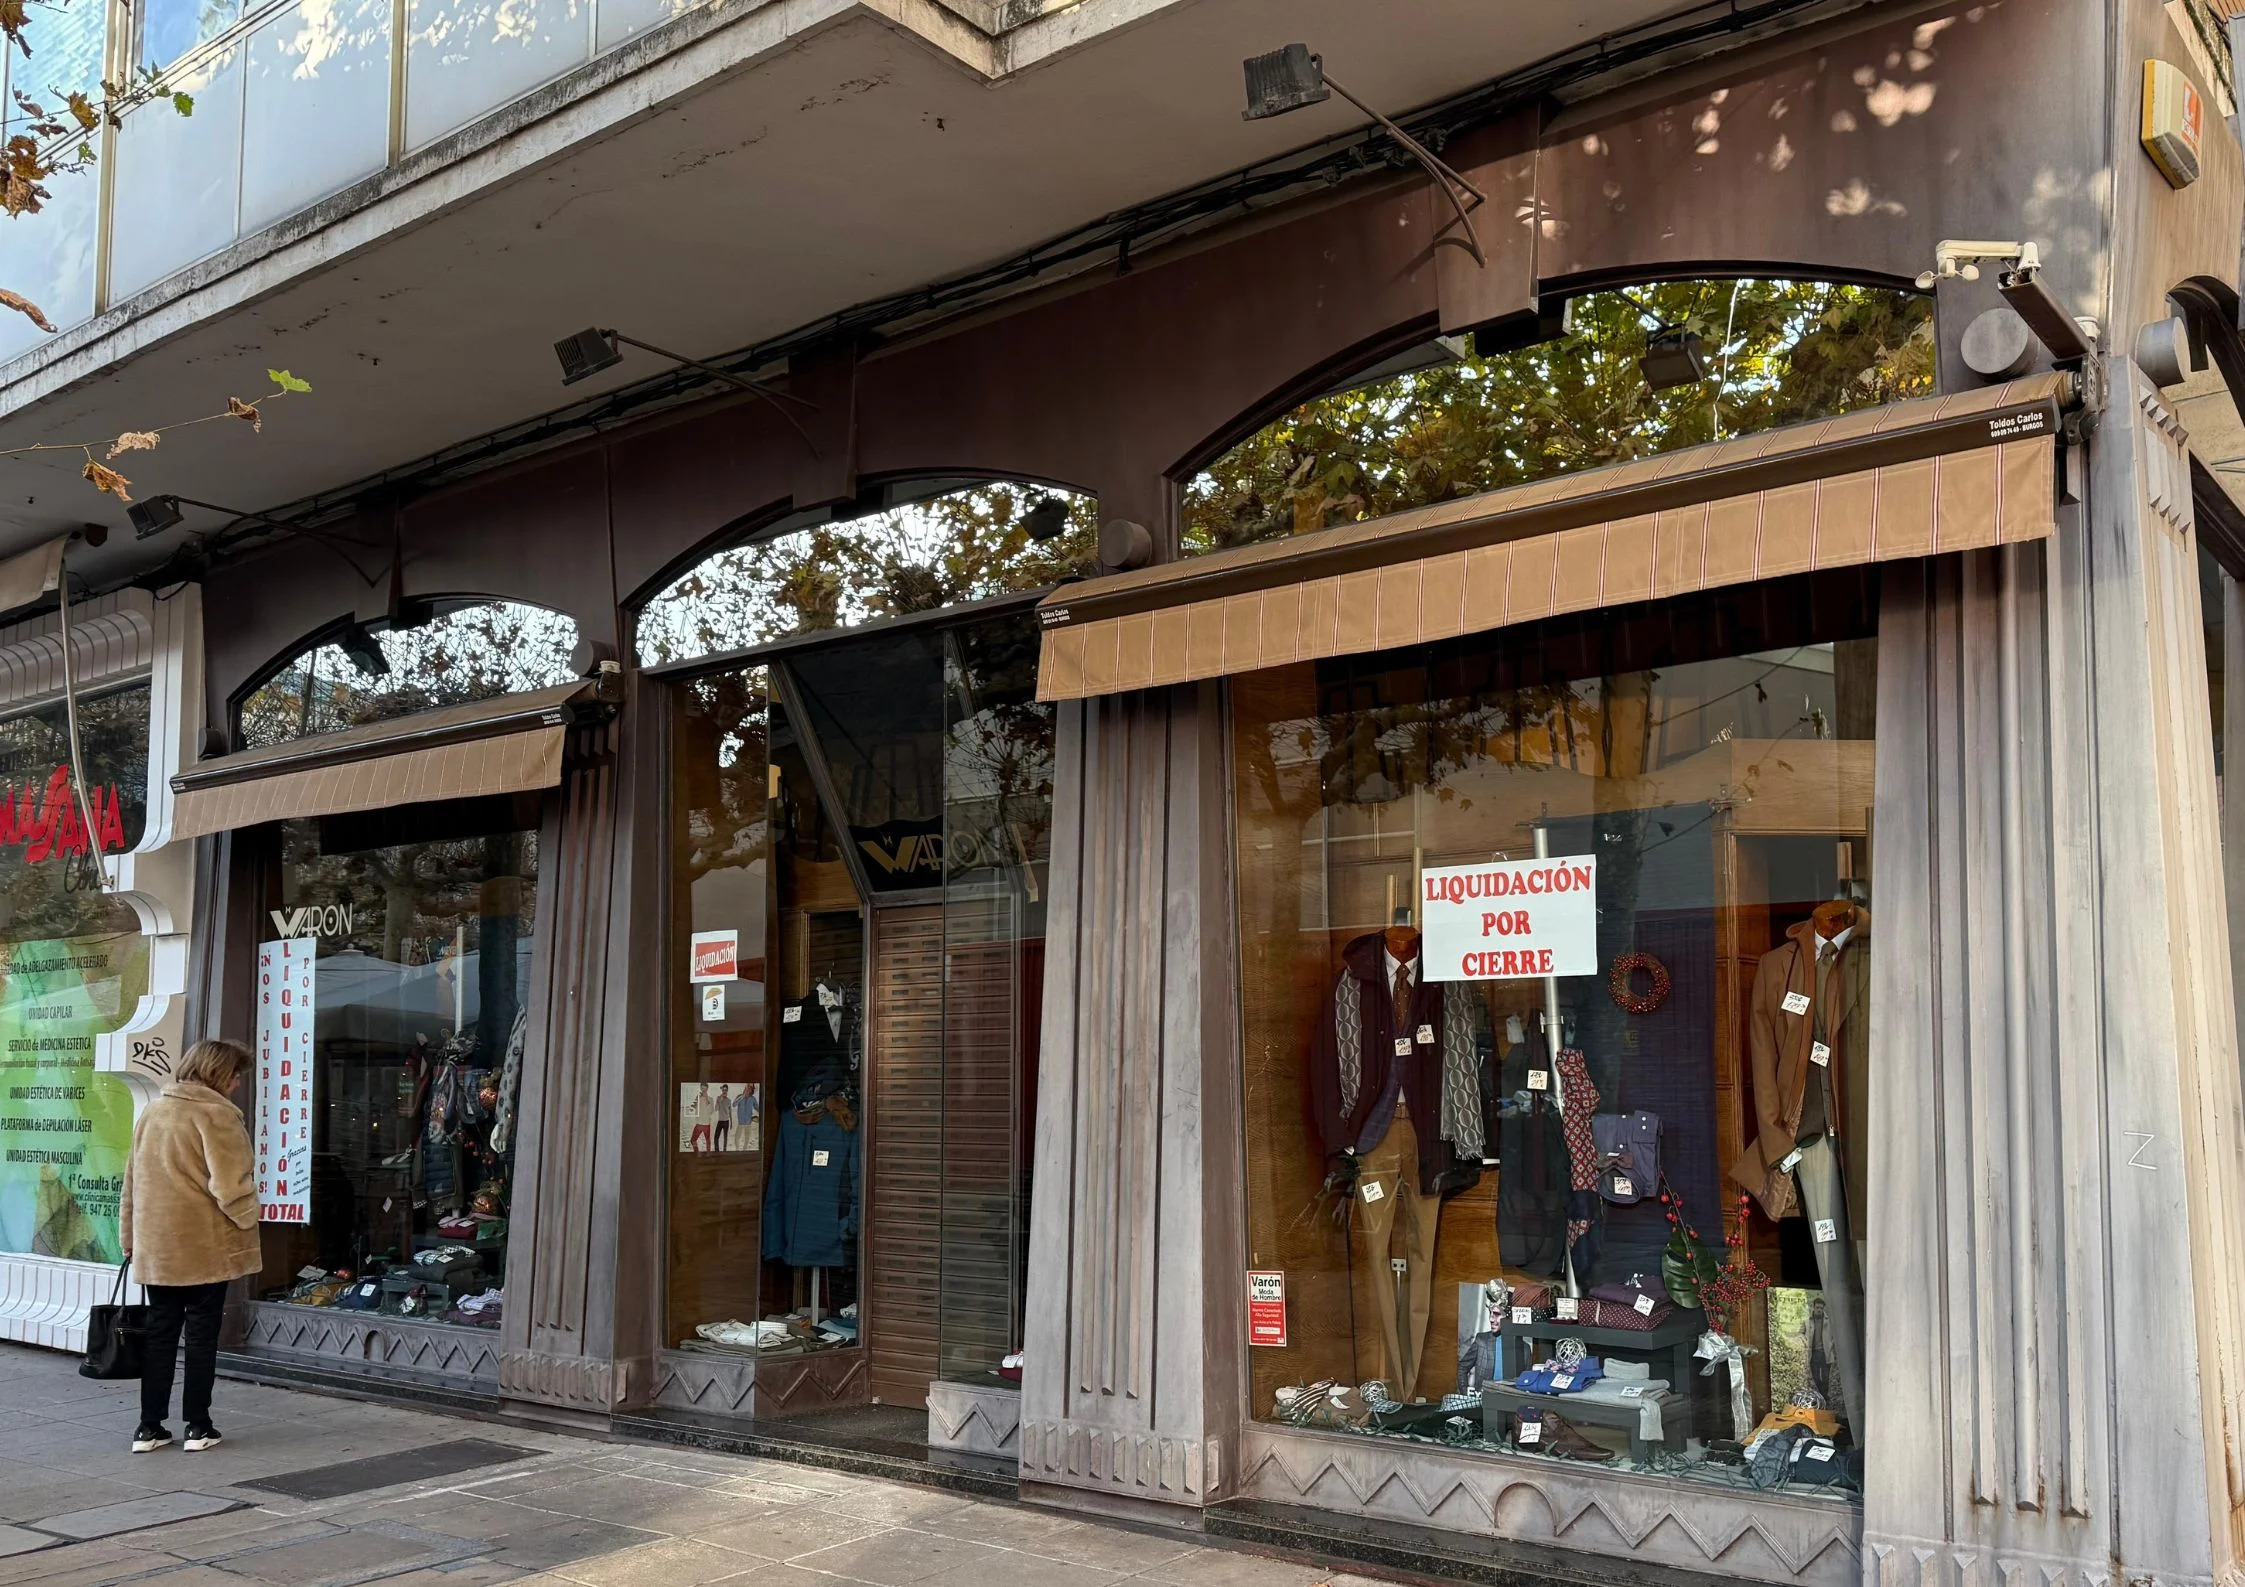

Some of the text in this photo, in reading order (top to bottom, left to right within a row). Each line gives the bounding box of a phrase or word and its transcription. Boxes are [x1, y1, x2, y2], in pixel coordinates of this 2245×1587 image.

[1988, 412, 2044, 430] Toldos Carlos
[2022, 421, 2044, 431] BURGOS
[1425, 860, 1592, 905] LIQUIDACIÓN
[1481, 910, 1532, 937] POR
[696, 943, 735, 973] LIQUIDACIÓN
[1462, 949, 1554, 977] CIERRE
[28, 1005, 73, 1020] UNIDAD CAPILAR
[8, 1039, 32, 1052] SERVICIO
[40, 1038, 66, 1051] MEDICINA
[300, 957, 310, 1139] POR CIERRE
[277, 942, 292, 1197] LIQUIDACIÓN
[10, 1087, 30, 1099] UNIDAD
[55, 1087, 62, 1099] DE
[63, 1087, 85, 1100] VARICES
[1, 1116, 92, 1132] PLATAFORMA de DEPILACIÓN LÁSER
[6, 1149, 26, 1162] UNIDAD
[51, 1151, 82, 1165] MASCULINA
[77, 1174, 109, 1191] Consulta
[90, 1203, 102, 1215] 947
[103, 1205, 112, 1217] 25
[259, 1203, 304, 1220] TOTAL
[1251, 1275, 1281, 1287] Varón
